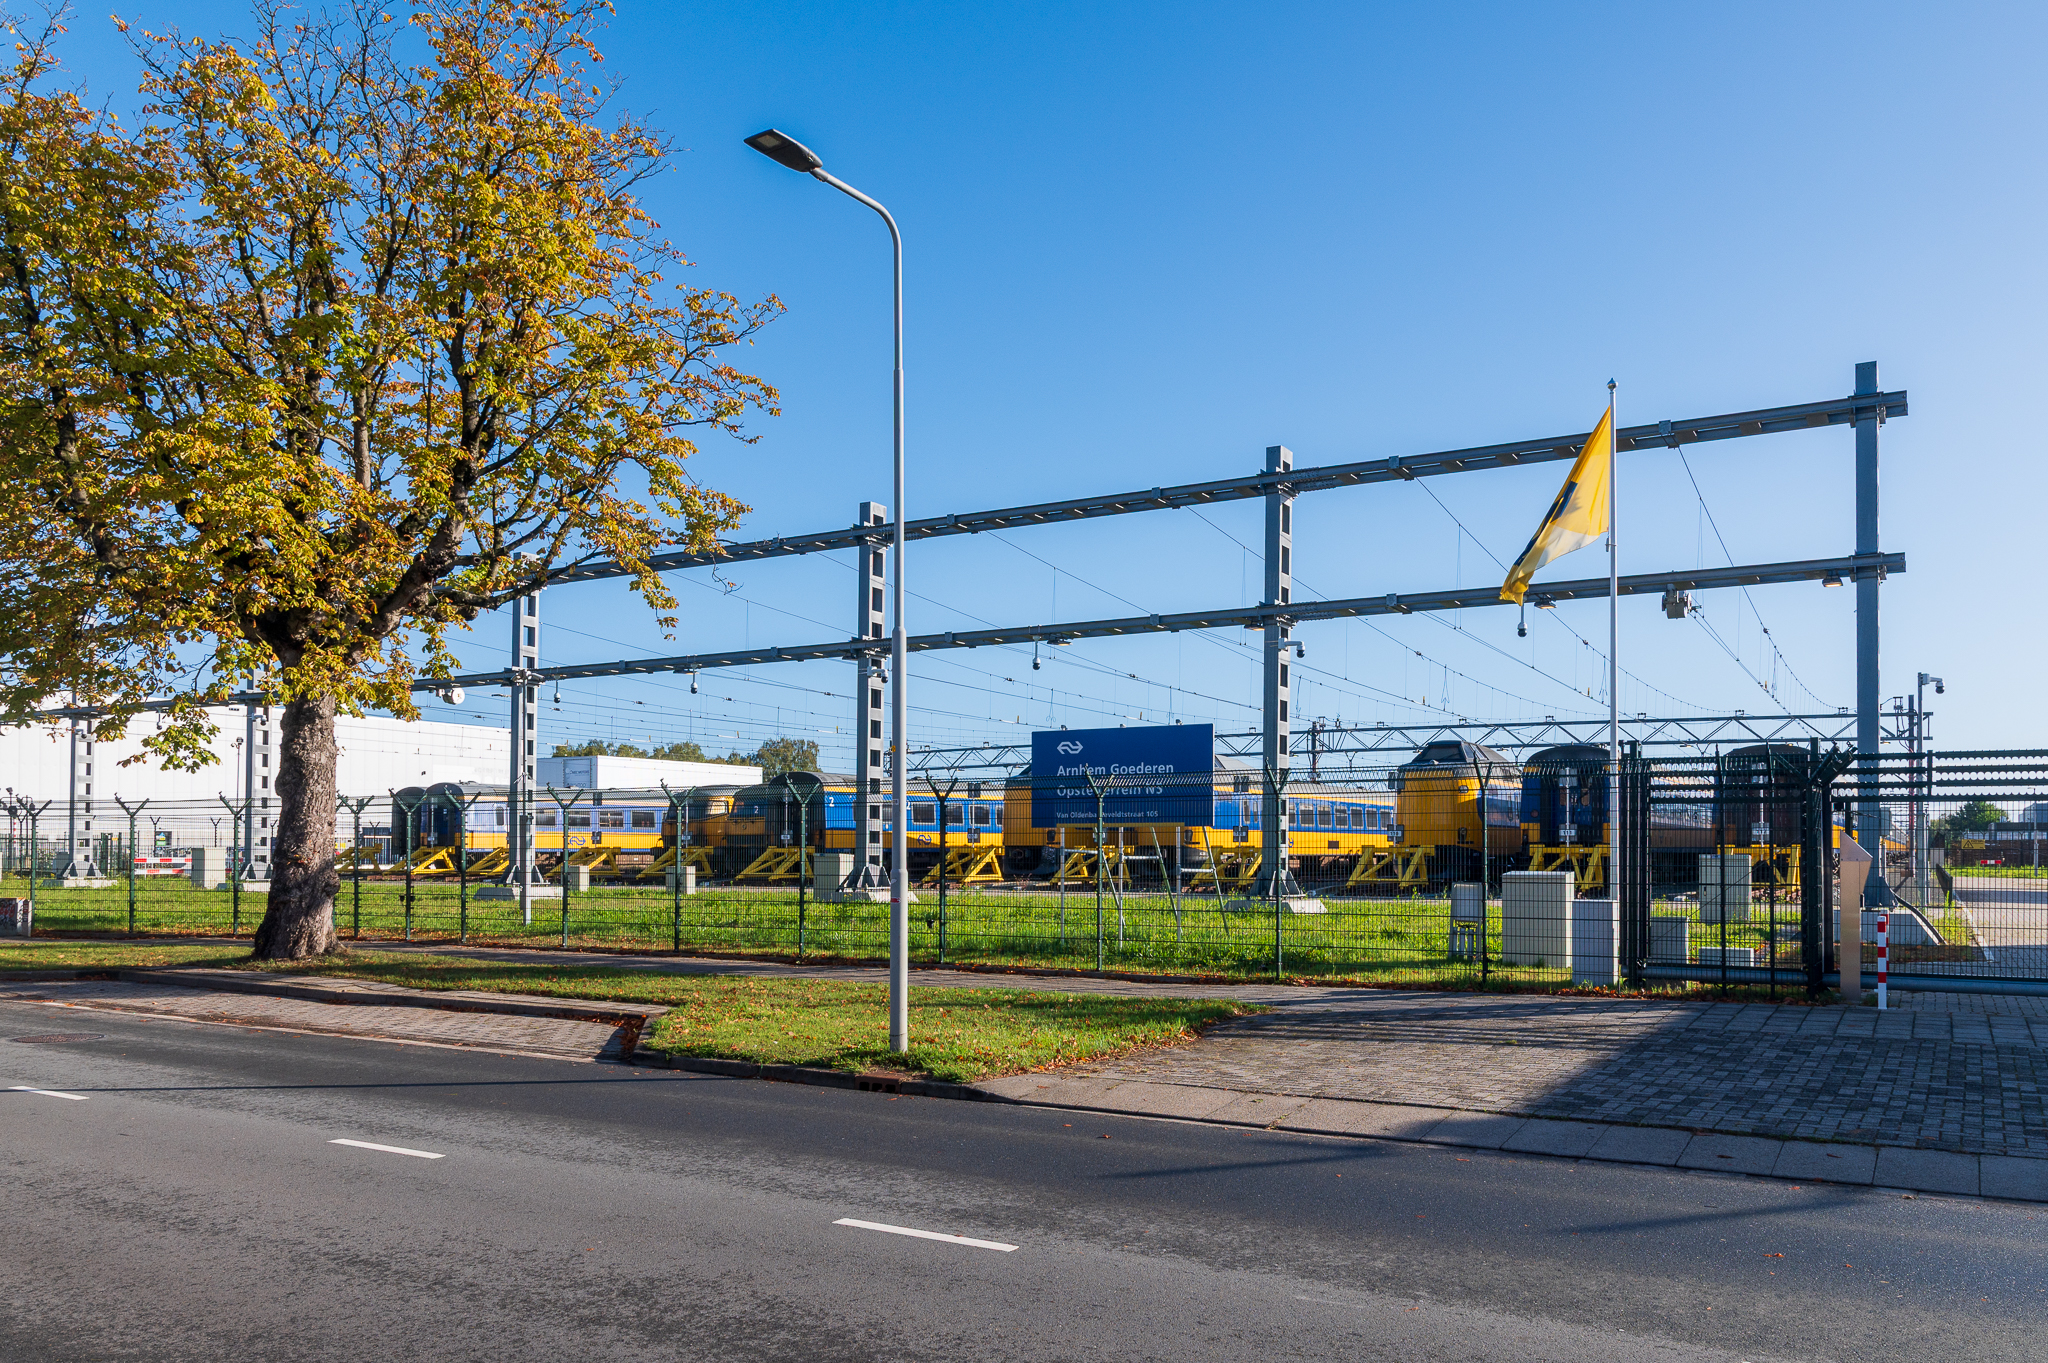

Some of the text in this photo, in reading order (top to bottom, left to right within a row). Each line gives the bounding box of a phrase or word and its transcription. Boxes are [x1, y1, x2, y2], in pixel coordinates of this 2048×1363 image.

[1057, 762, 1174, 776] Arnhem Goederen
[1057, 783, 1163, 798] Opsteerrein NS
[829, 796, 835, 807] 2
